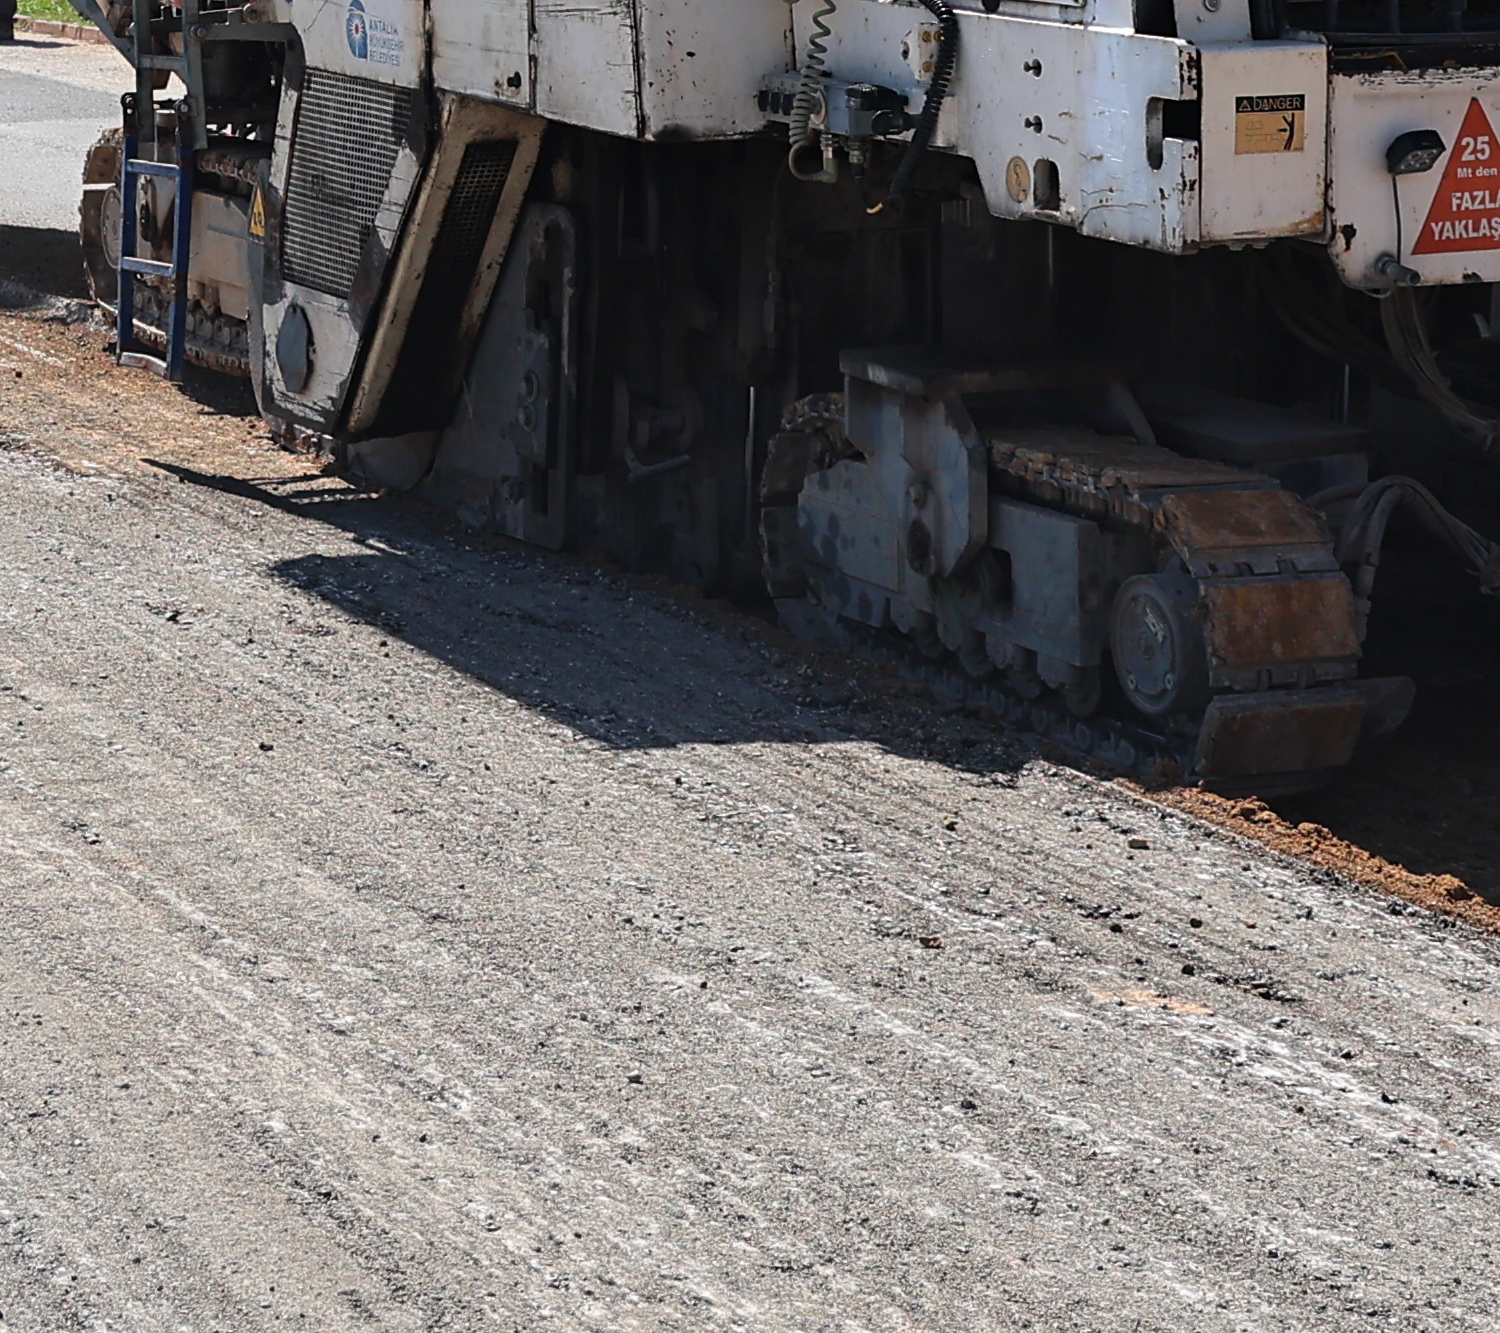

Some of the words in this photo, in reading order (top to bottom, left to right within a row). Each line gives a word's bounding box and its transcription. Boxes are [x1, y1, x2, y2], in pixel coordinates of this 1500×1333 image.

[1253, 96, 1300, 111] DANGER
[1461, 135, 1491, 161] 25
[1457, 167, 1472, 178] Mt
[1475, 166, 1498, 177] den
